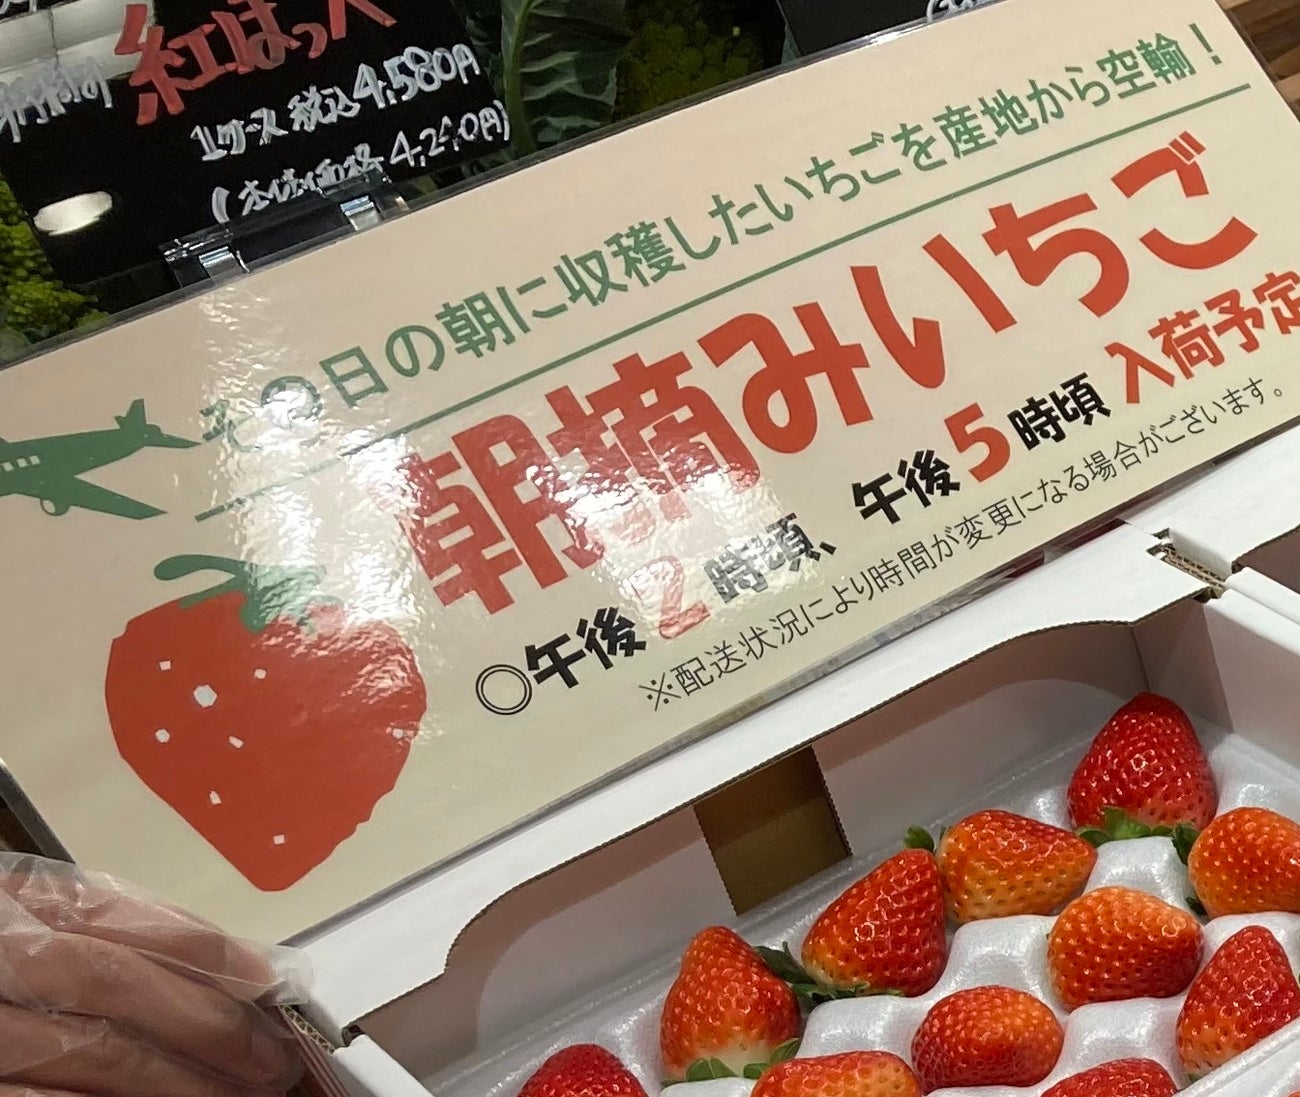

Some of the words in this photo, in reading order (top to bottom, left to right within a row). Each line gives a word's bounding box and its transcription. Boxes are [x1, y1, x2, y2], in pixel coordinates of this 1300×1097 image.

[397, 131, 1258, 615] 朝摘みいちご
